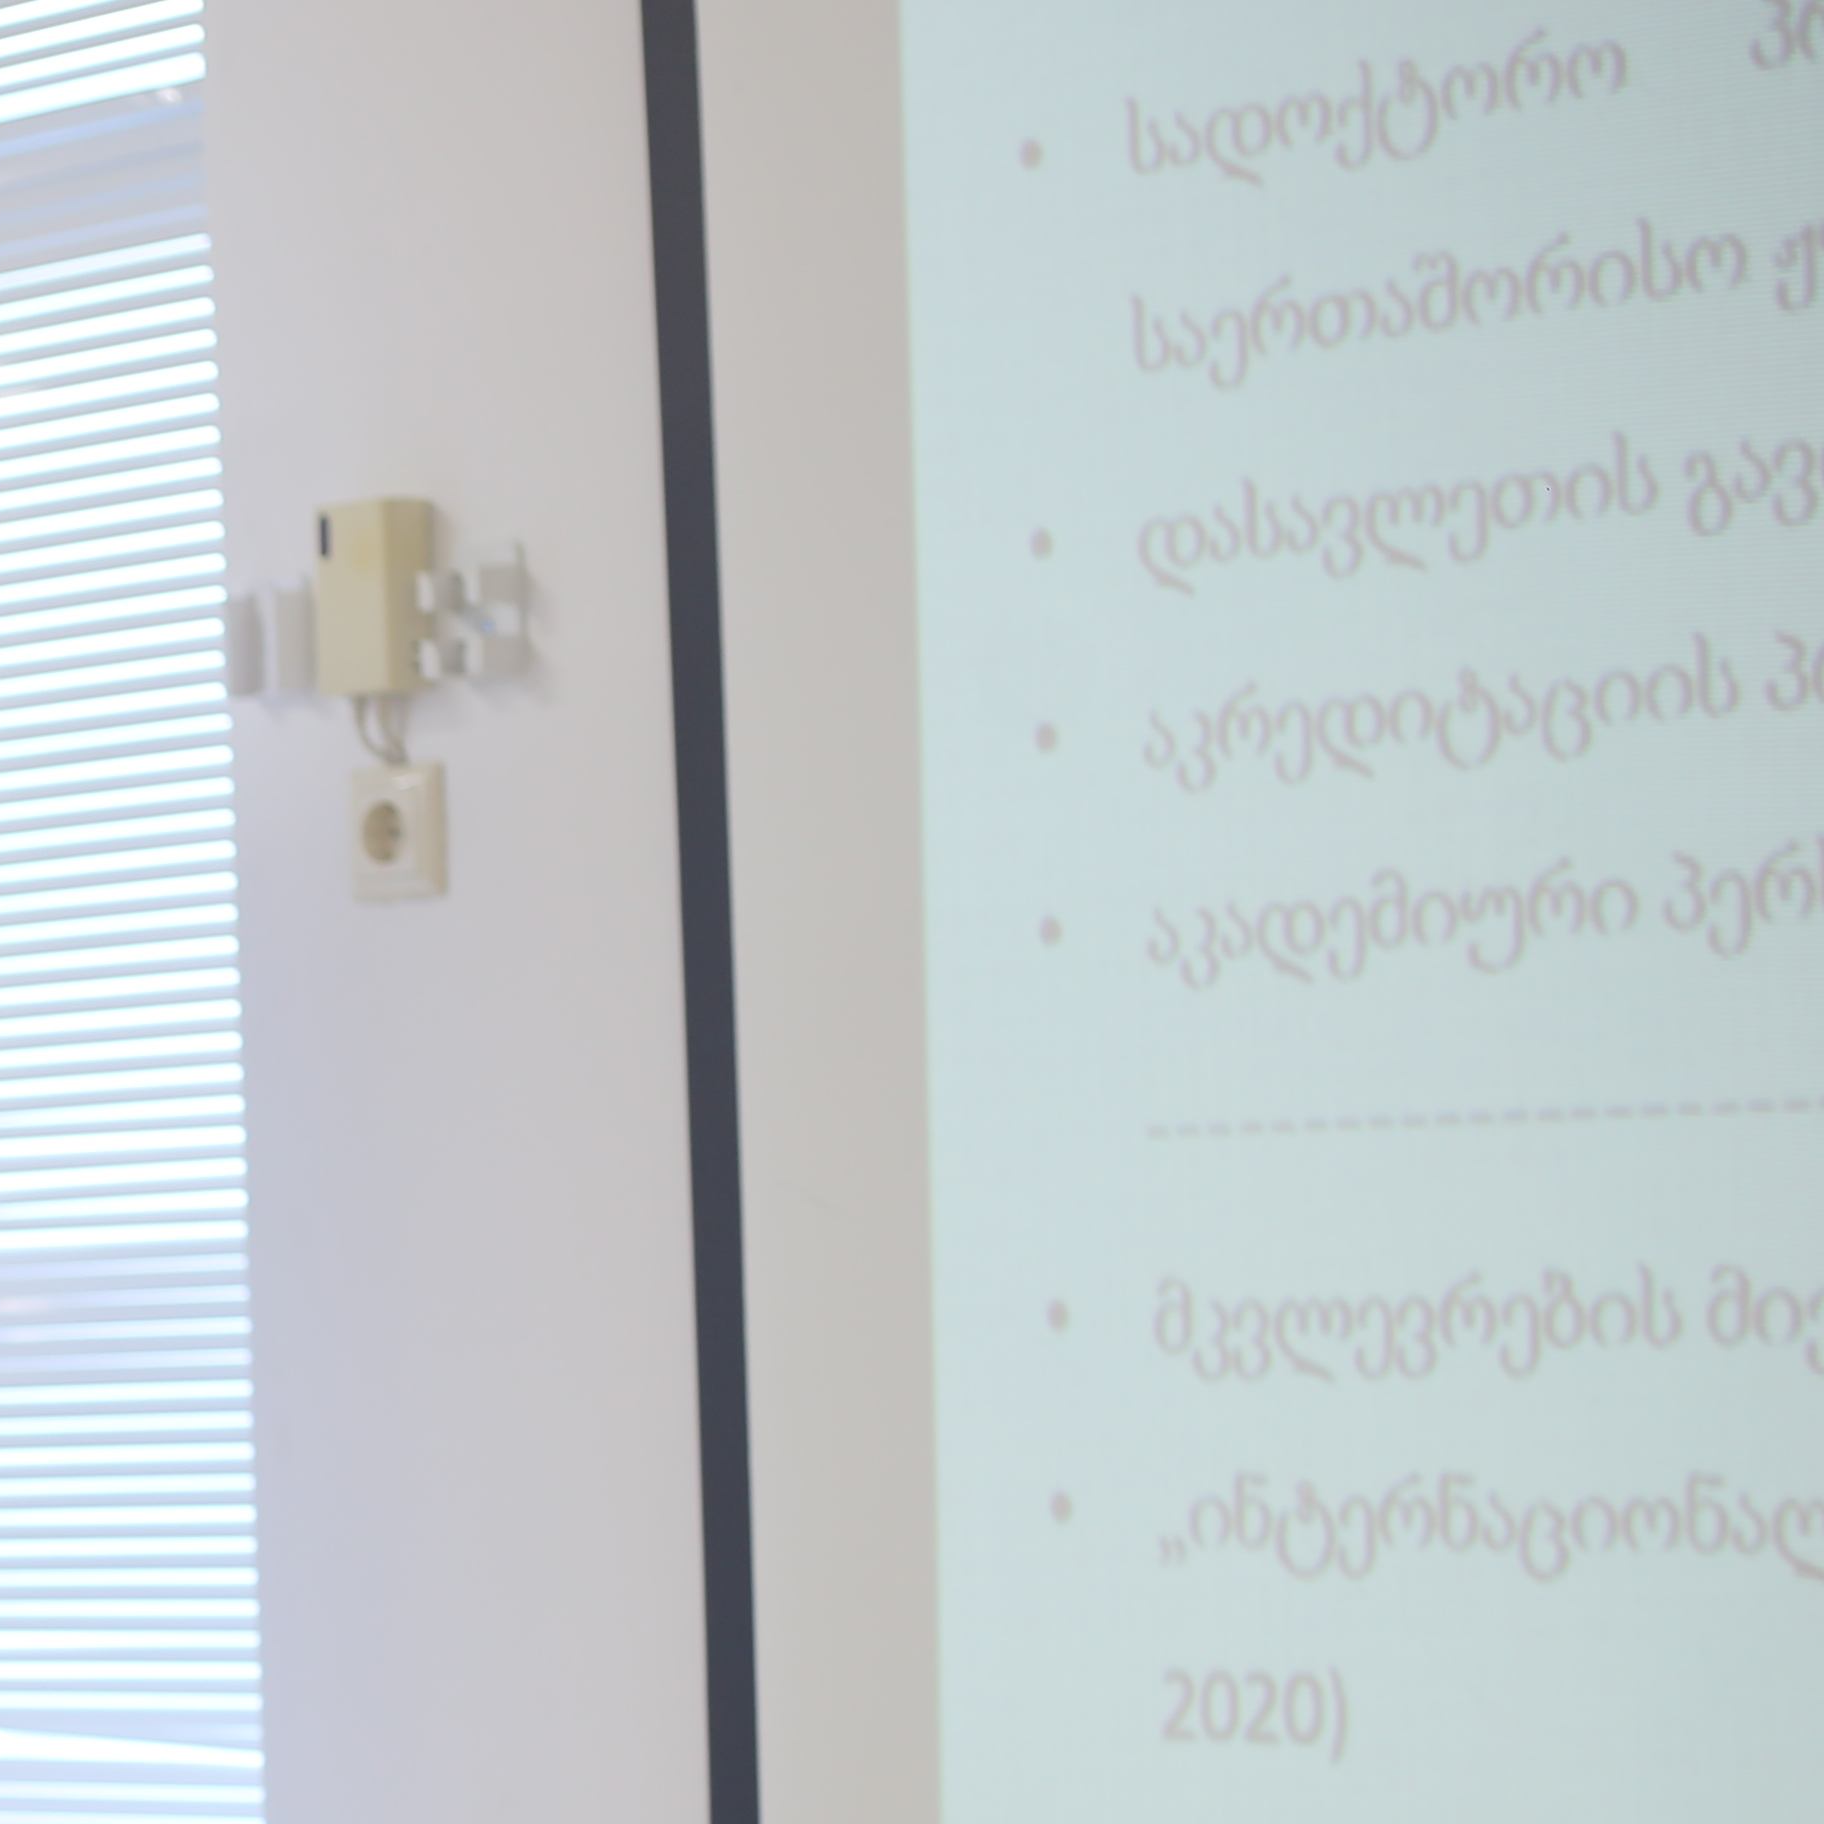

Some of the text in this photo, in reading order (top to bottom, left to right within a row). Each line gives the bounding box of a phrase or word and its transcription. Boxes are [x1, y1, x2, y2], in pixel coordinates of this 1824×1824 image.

[1125, 26, 1628, 186] სადოქტორო
[1130, 217, 1748, 389] საერთაშორისო
[1137, 431, 1658, 595] დასავლეთის
[1143, 632, 1740, 792] აკრედიტაციის
[1146, 833, 1824, 989] აკადემიური პერ
[1153, 1263, 1683, 1382] მკვლევრების
[1161, 1668, 1347, 1763] 2020)
